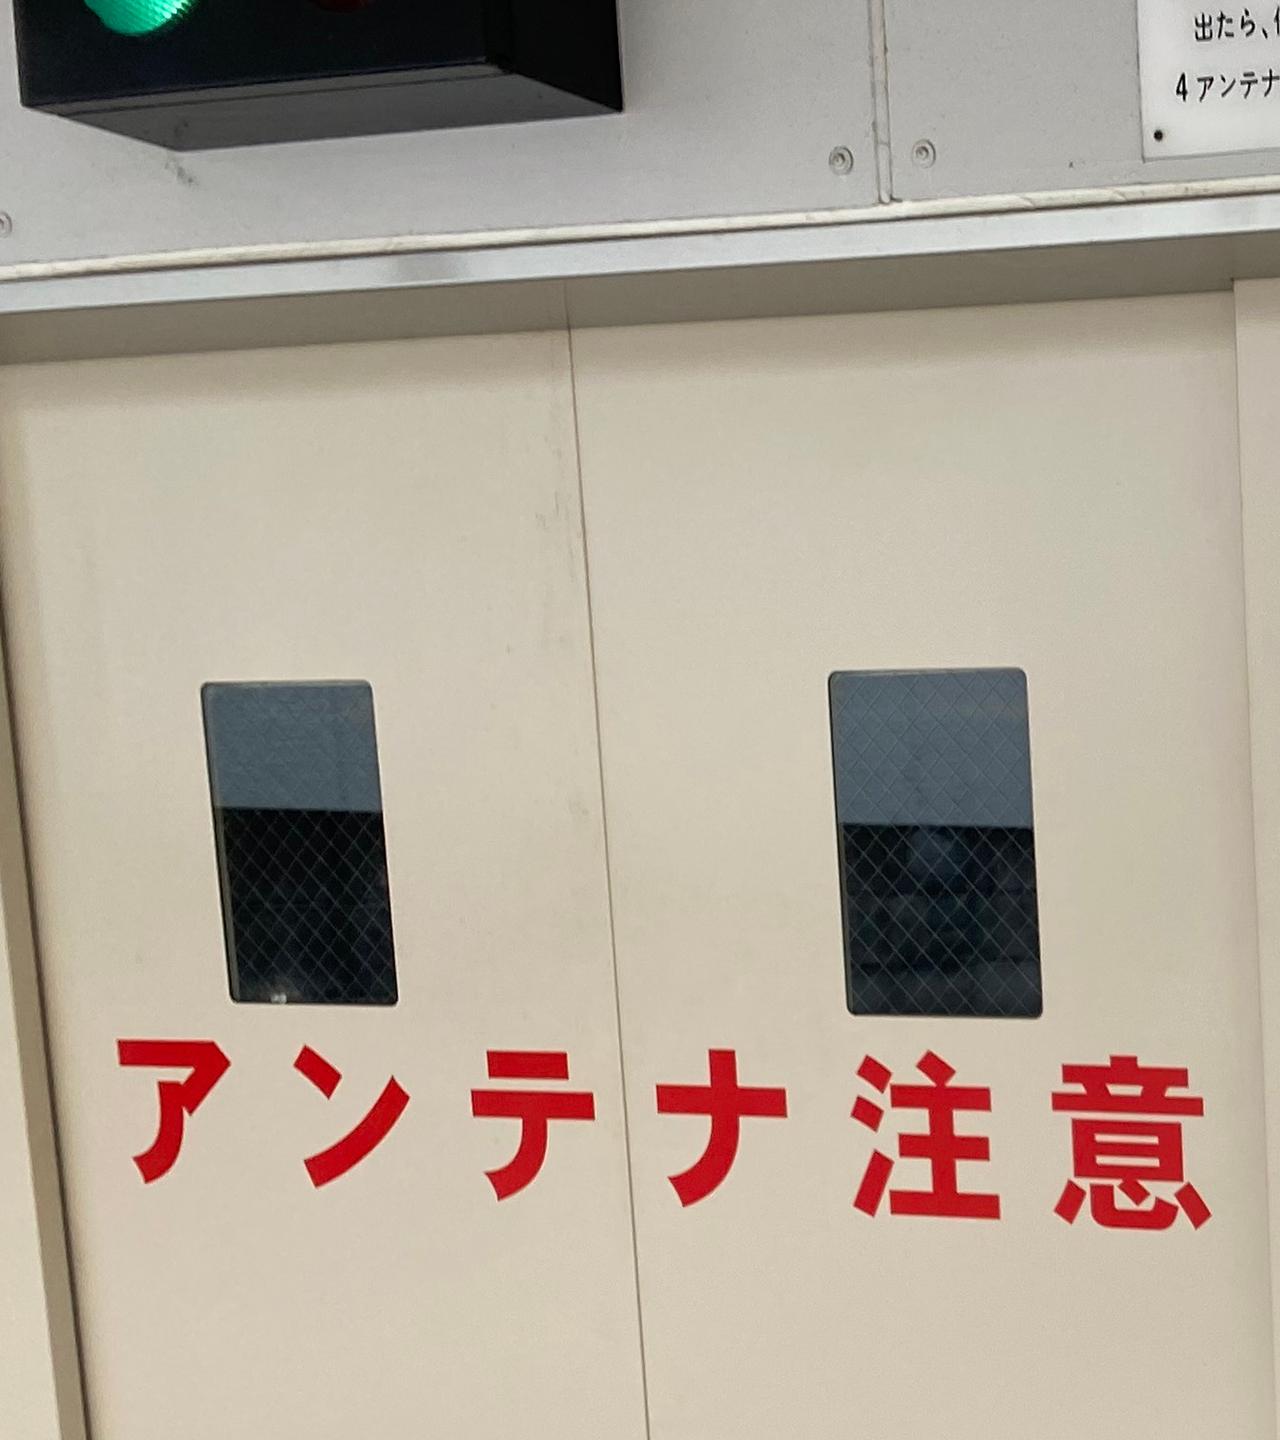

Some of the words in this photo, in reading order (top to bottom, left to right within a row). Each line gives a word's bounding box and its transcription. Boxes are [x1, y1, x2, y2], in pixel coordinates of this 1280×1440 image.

[116, 1037, 1215, 1233] アンテナ注意
